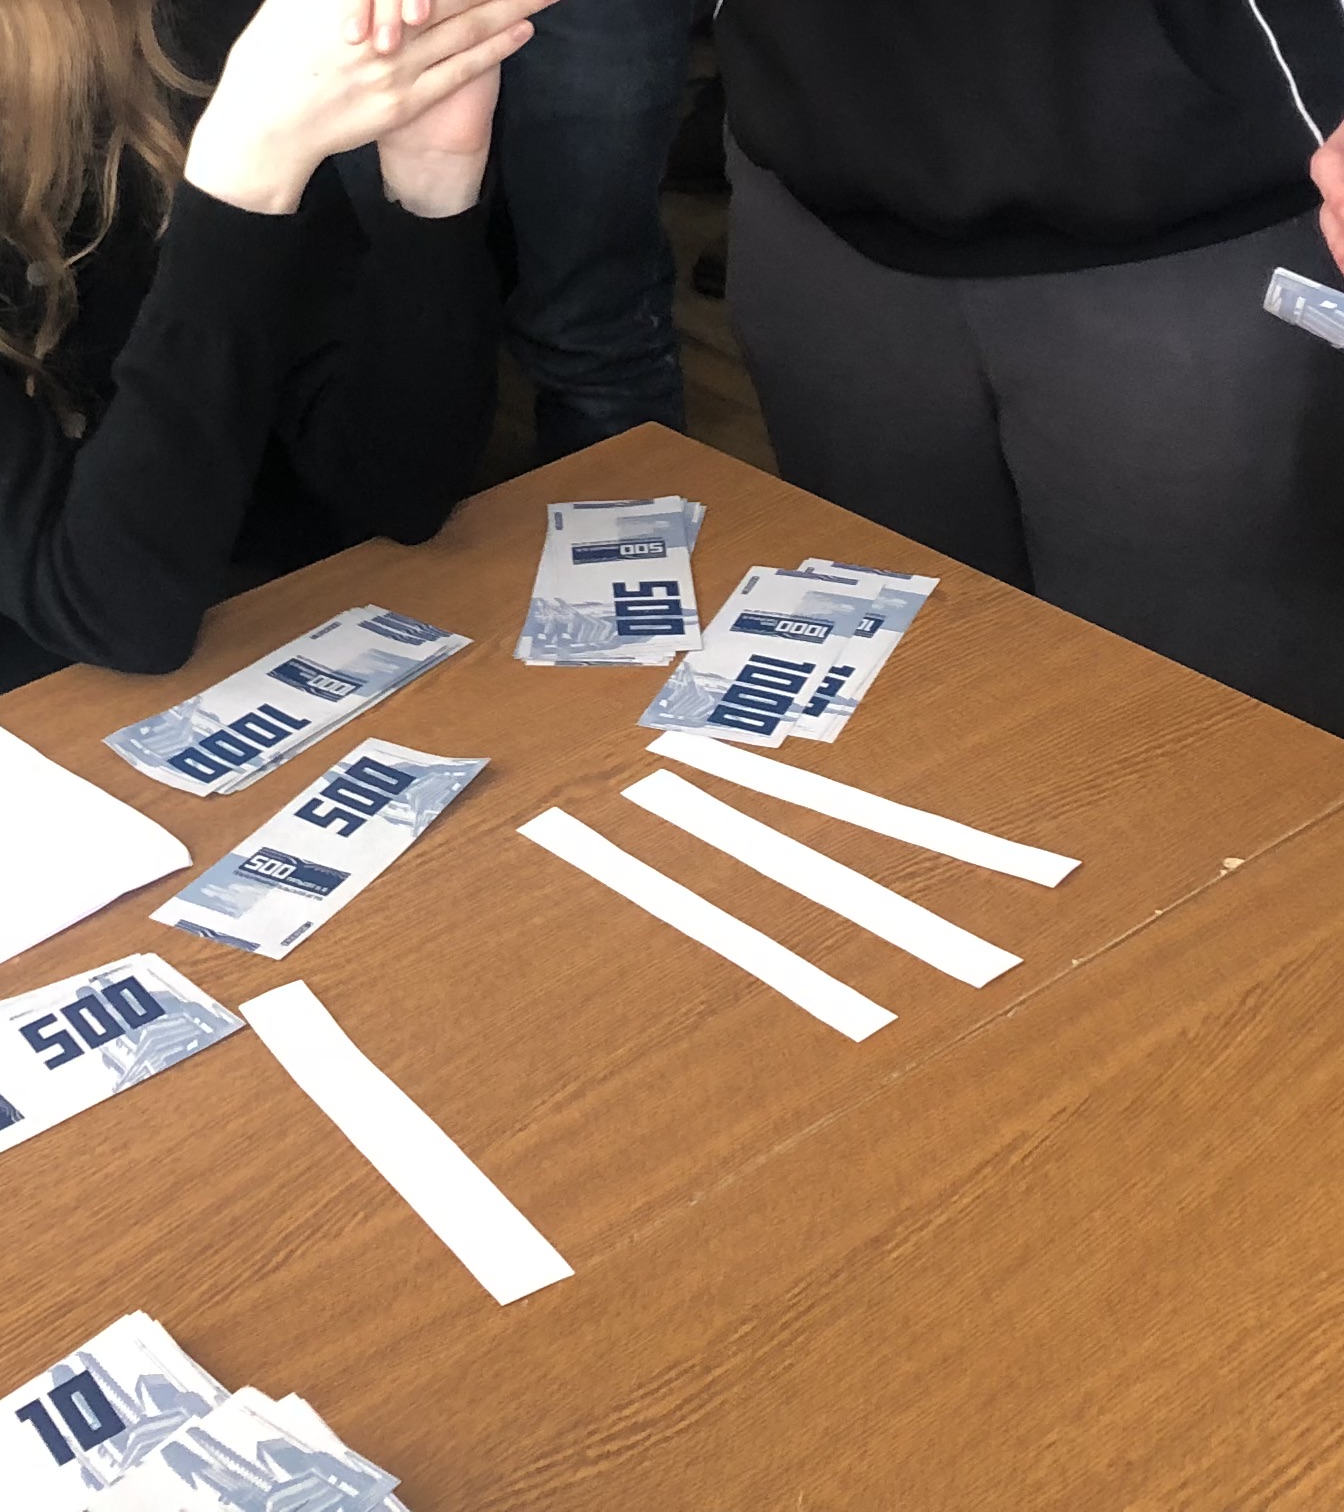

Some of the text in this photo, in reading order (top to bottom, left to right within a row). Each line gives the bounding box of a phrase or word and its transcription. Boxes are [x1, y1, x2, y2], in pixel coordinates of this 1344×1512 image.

[619, 542, 665, 556] 500
[612, 580, 685, 636] 500
[775, 620, 829, 638] 1000
[707, 654, 816, 736] 1000
[167, 703, 312, 783] 1000
[294, 756, 416, 837] 500
[244, 854, 297, 880] 500
[18, 975, 166, 1070] 500
[15, 1369, 126, 1466] 10
